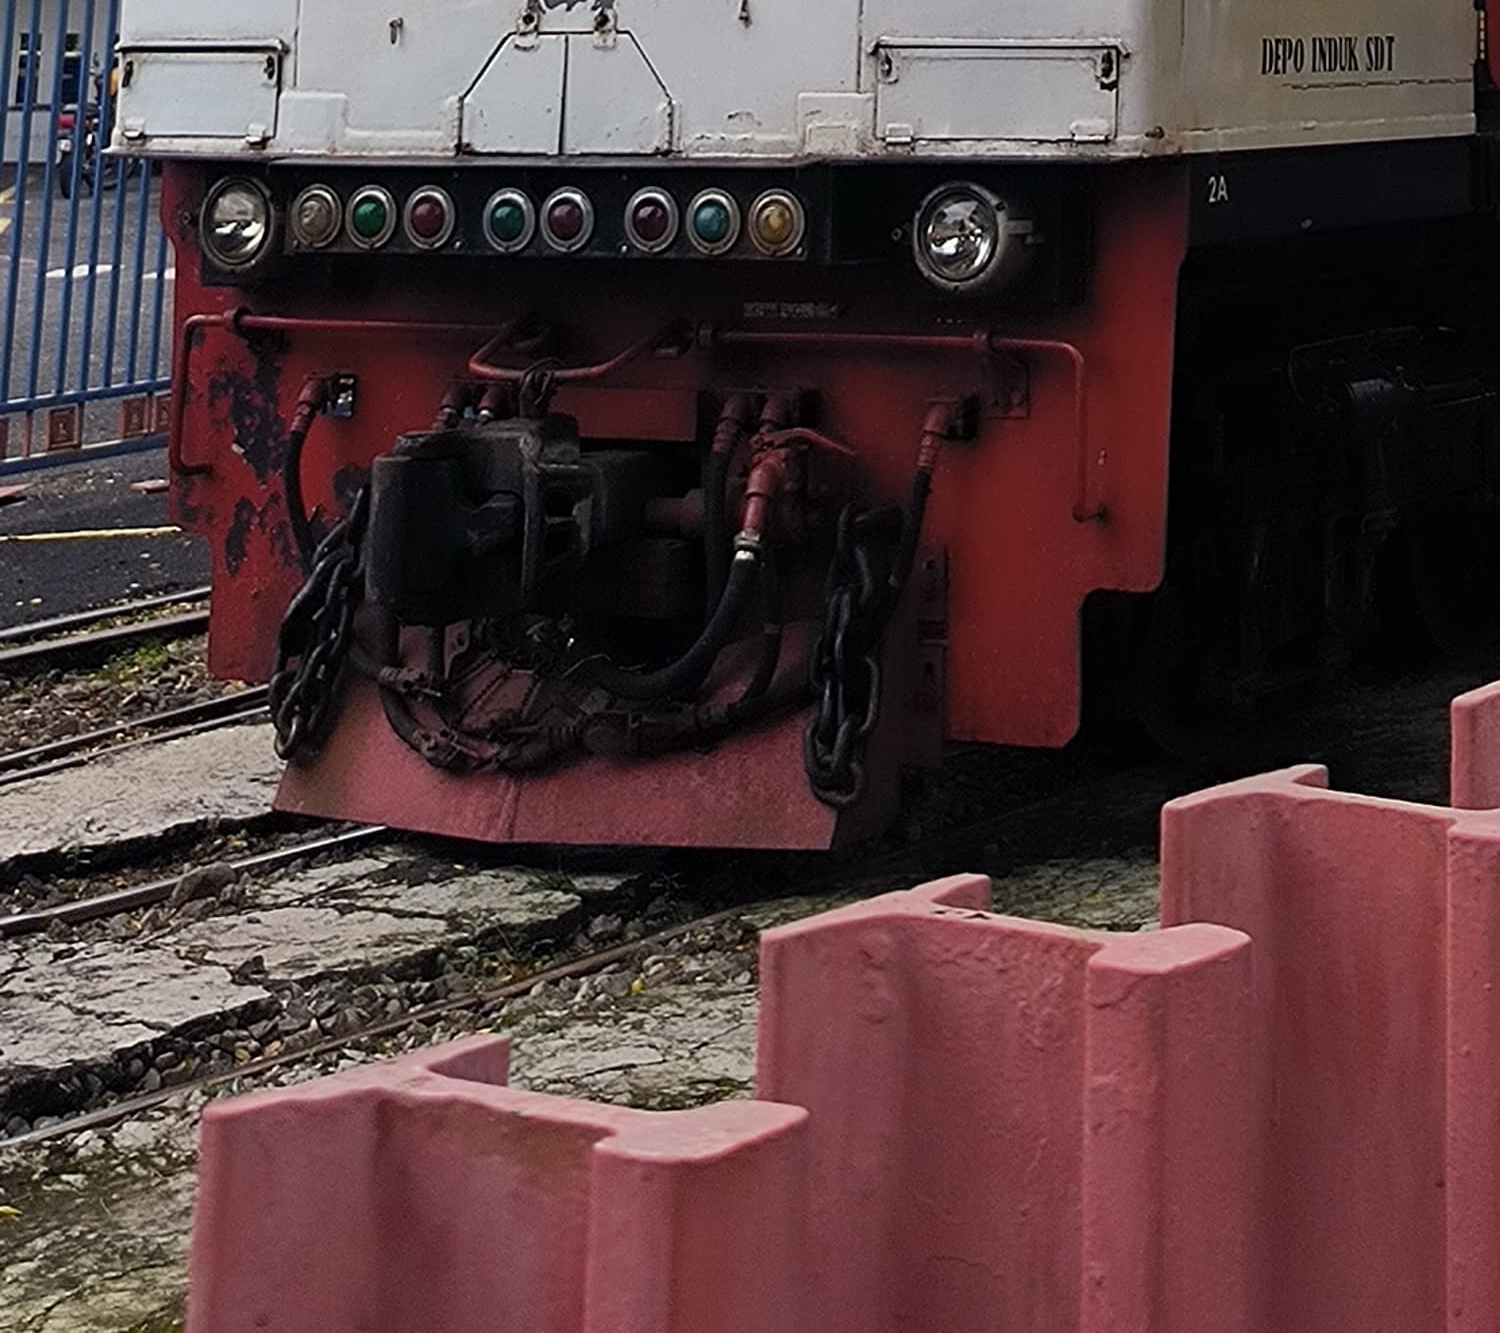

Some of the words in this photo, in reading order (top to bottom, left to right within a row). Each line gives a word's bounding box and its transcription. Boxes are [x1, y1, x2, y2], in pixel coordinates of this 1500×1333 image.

[1261, 37, 1305, 75] DEPO
[1311, 35, 1359, 73] INDUK
[1365, 35, 1396, 72] SDT
[1207, 174, 1229, 203] 2A
